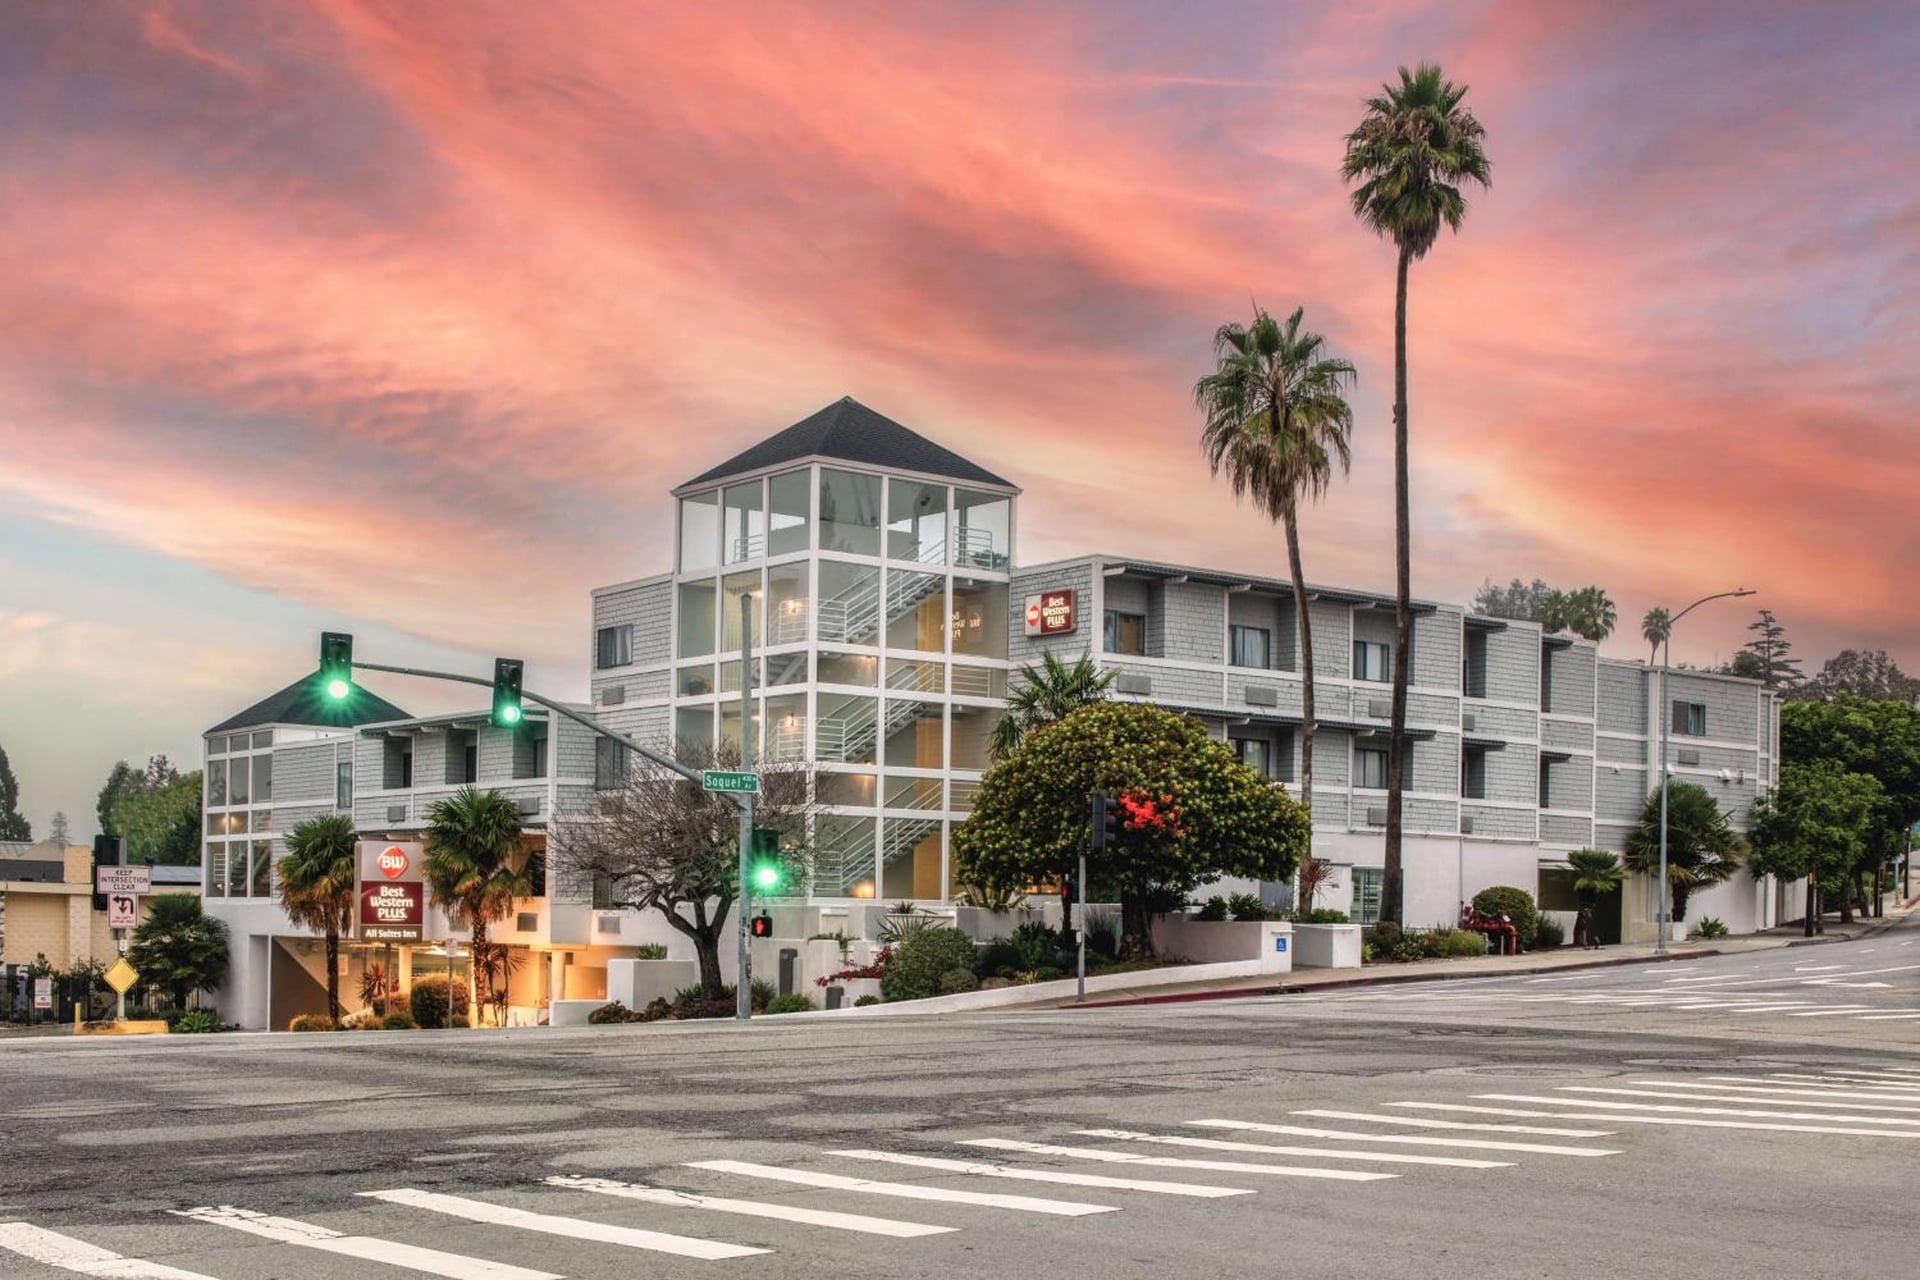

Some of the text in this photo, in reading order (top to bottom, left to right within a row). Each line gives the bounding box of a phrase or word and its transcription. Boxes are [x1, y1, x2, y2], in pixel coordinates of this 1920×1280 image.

[1049, 597, 1064, 607] Best
[1042, 606, 1070, 617] Western
[1047, 616, 1066, 626] PLUS
[706, 774, 741, 789] Soquel
[381, 856, 404, 869] BW
[380, 886, 404, 897] Best
[370, 896, 414, 908] Western
[365, 929, 417, 938] All Suites Inn
